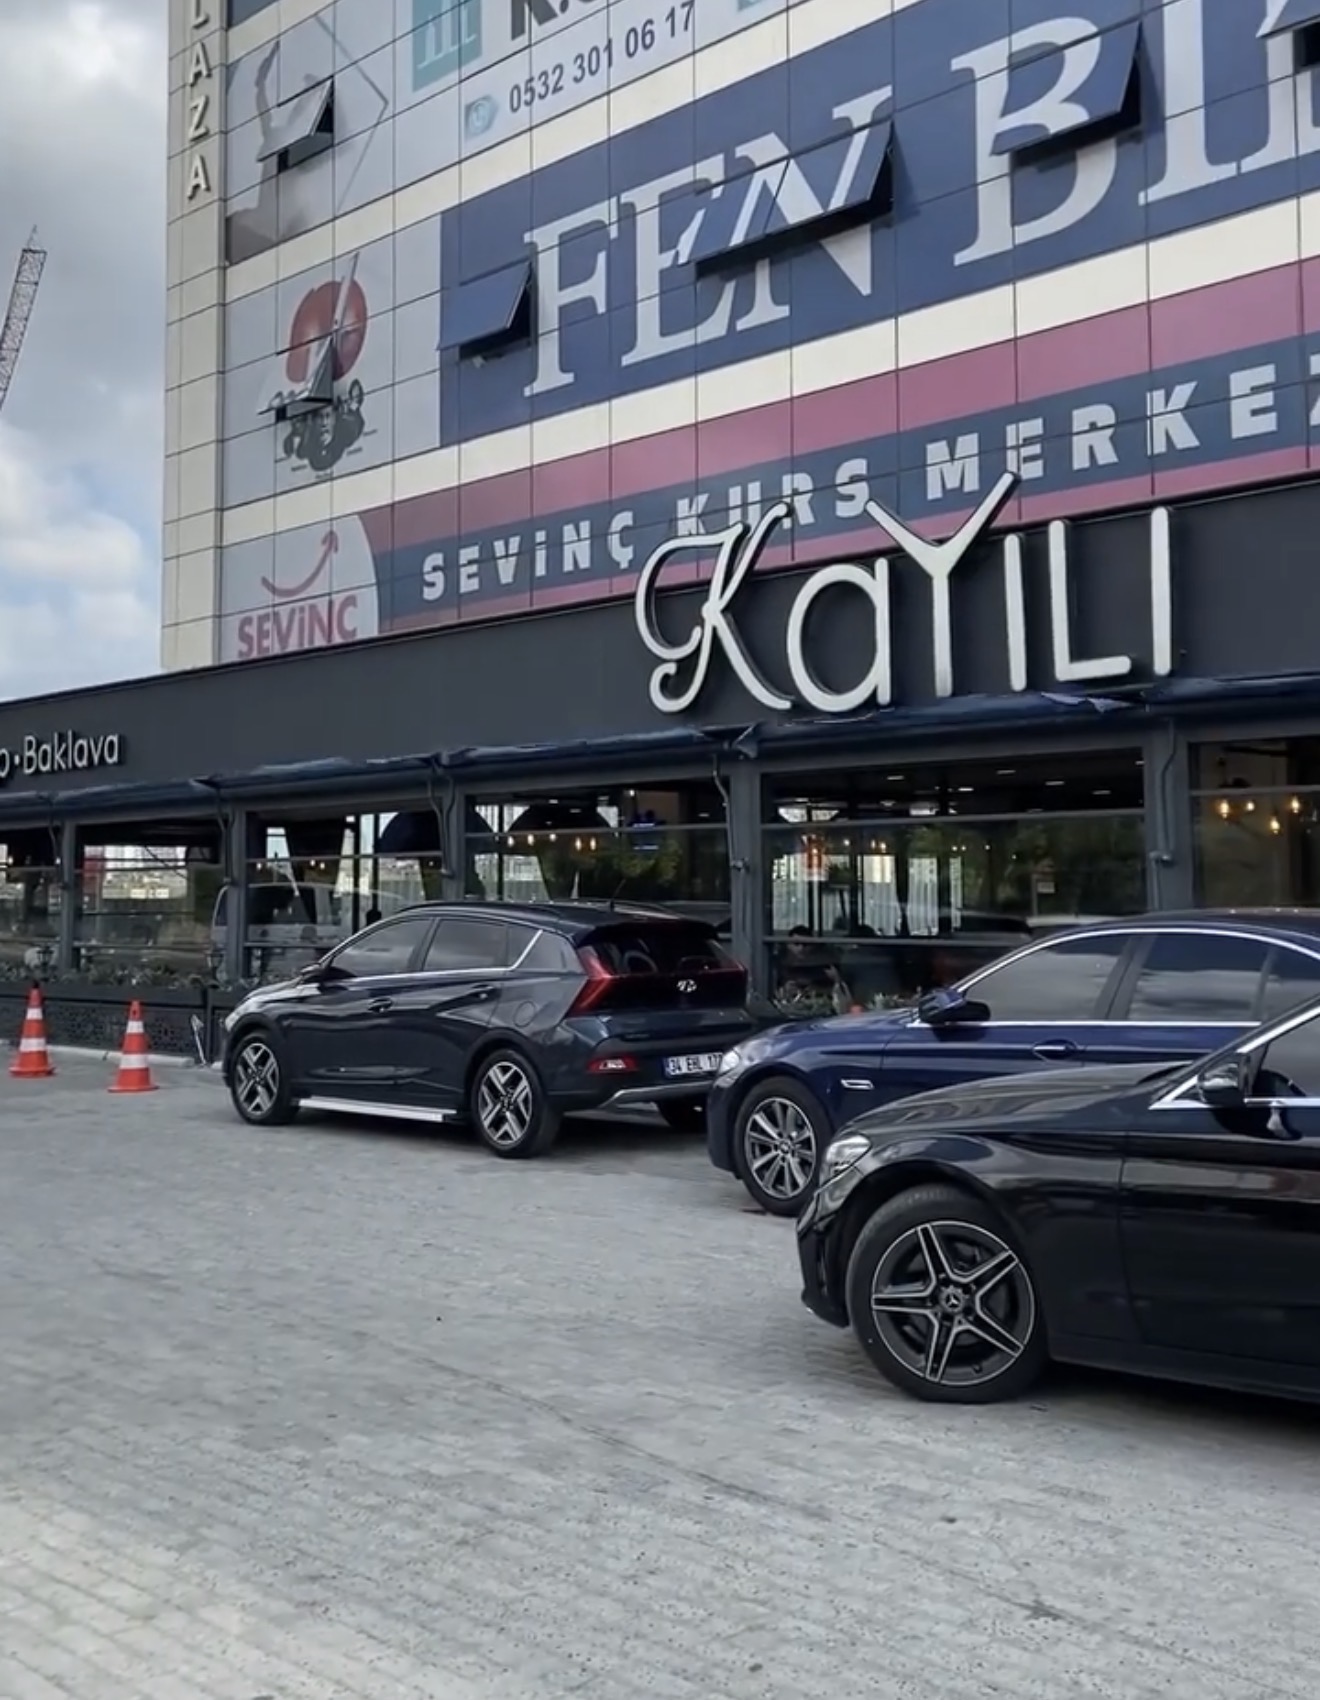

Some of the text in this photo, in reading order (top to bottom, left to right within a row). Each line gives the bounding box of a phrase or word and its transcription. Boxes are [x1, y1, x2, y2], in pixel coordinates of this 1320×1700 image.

[509, 63, 564, 113] 0532
[572, 38, 613, 84] 301
[624, 18, 655, 58] 06
[664, 0, 695, 39] 17
[524, 84, 893, 397] FEN
[676, 458, 870, 537] KURS
[665, 1057, 682, 1074] 34
